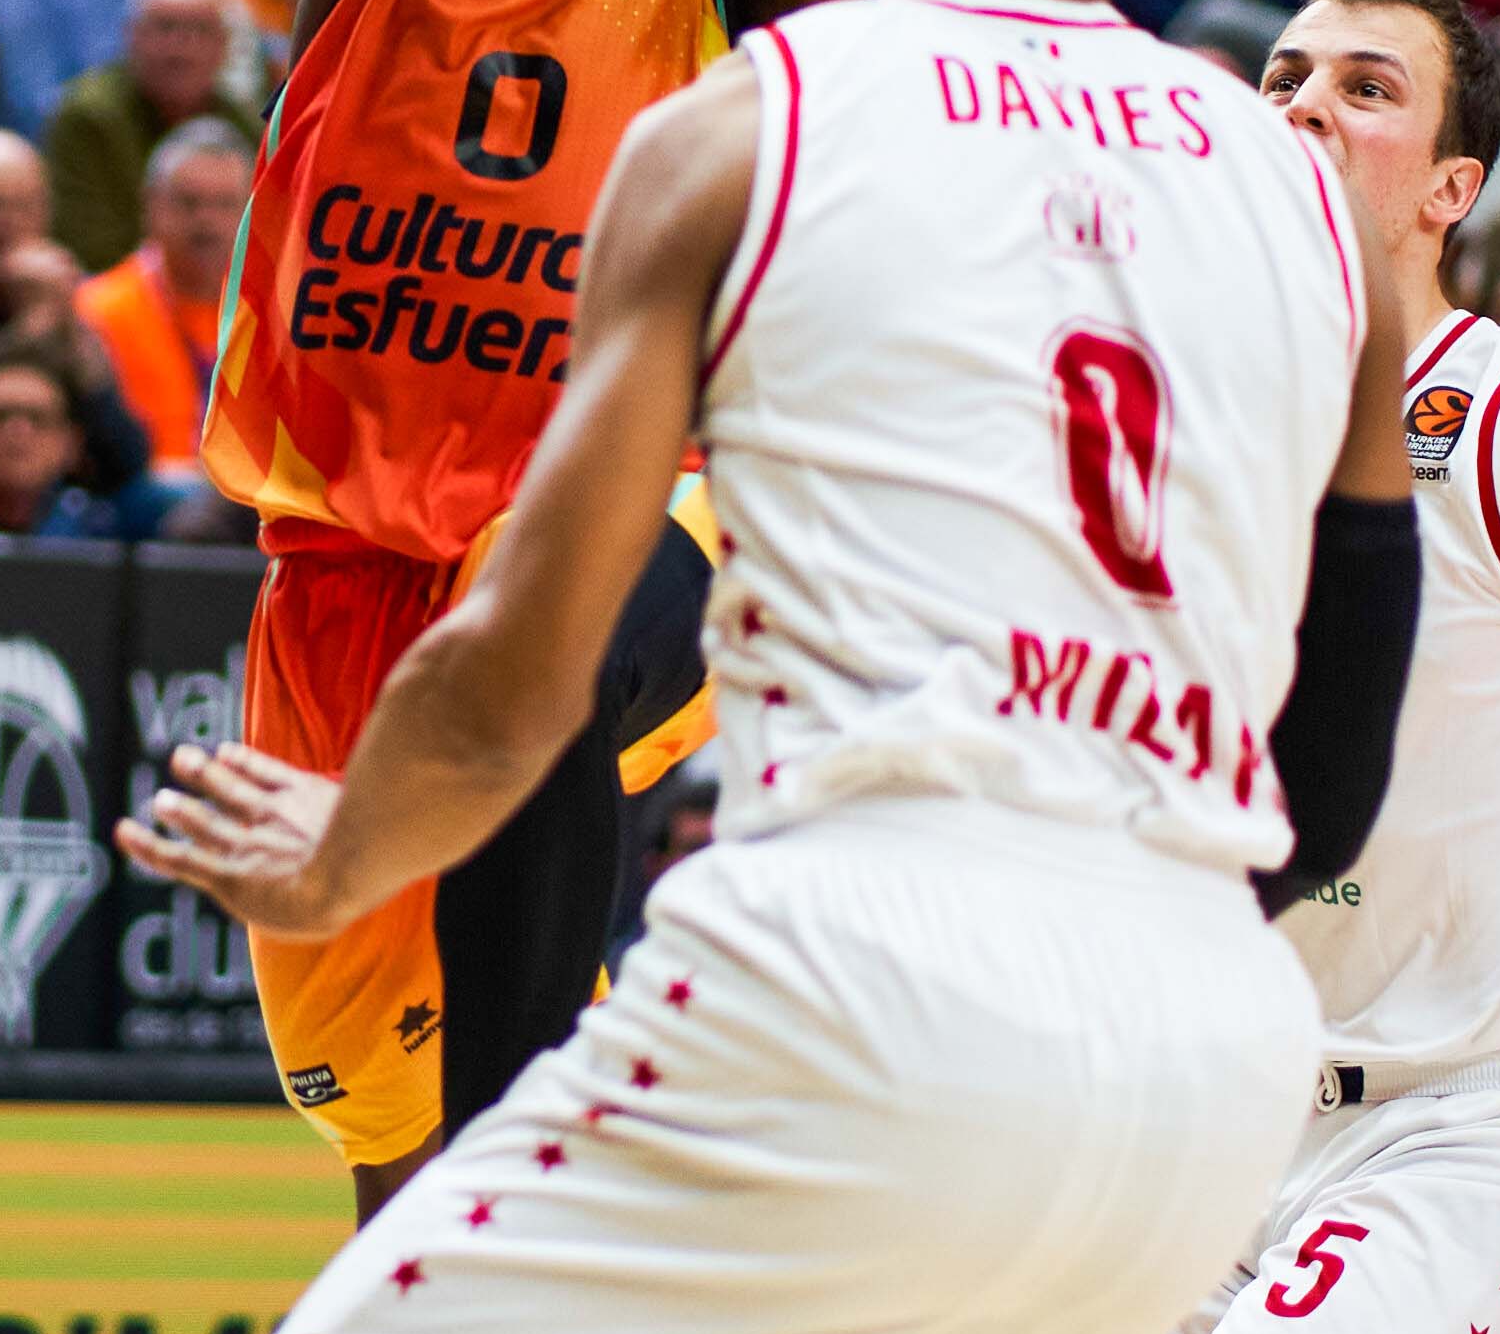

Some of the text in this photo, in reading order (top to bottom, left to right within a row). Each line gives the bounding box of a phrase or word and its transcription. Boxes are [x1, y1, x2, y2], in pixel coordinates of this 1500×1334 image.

[454, 51, 567, 181] 0
[291, 267, 575, 382] Esfuer
[1040, 317, 1178, 610] 0
[1405, 433, 1453, 444] TURKISH
[1405, 442, 1449, 452] IRLINES
[289, 1069, 333, 1087] PULEVA
[1265, 1219, 1370, 1318] 5
